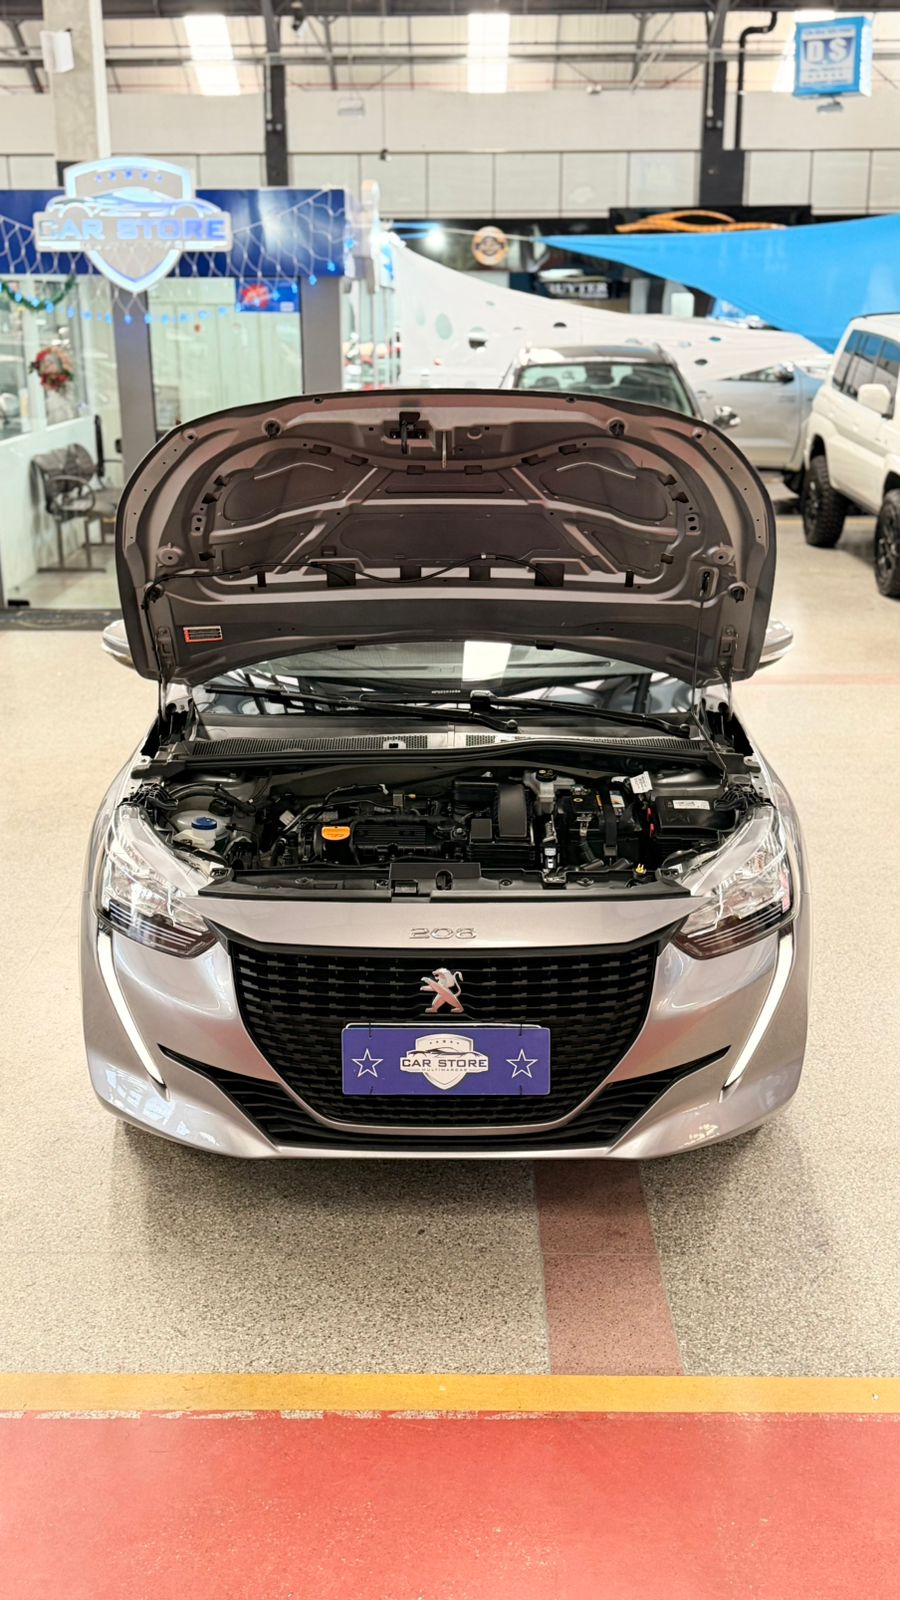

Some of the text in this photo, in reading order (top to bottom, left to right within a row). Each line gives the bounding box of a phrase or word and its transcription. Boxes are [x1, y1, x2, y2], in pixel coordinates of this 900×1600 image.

[39, 218, 226, 241] CAR STORE
[402, 1059, 488, 1068] CAR STORE
